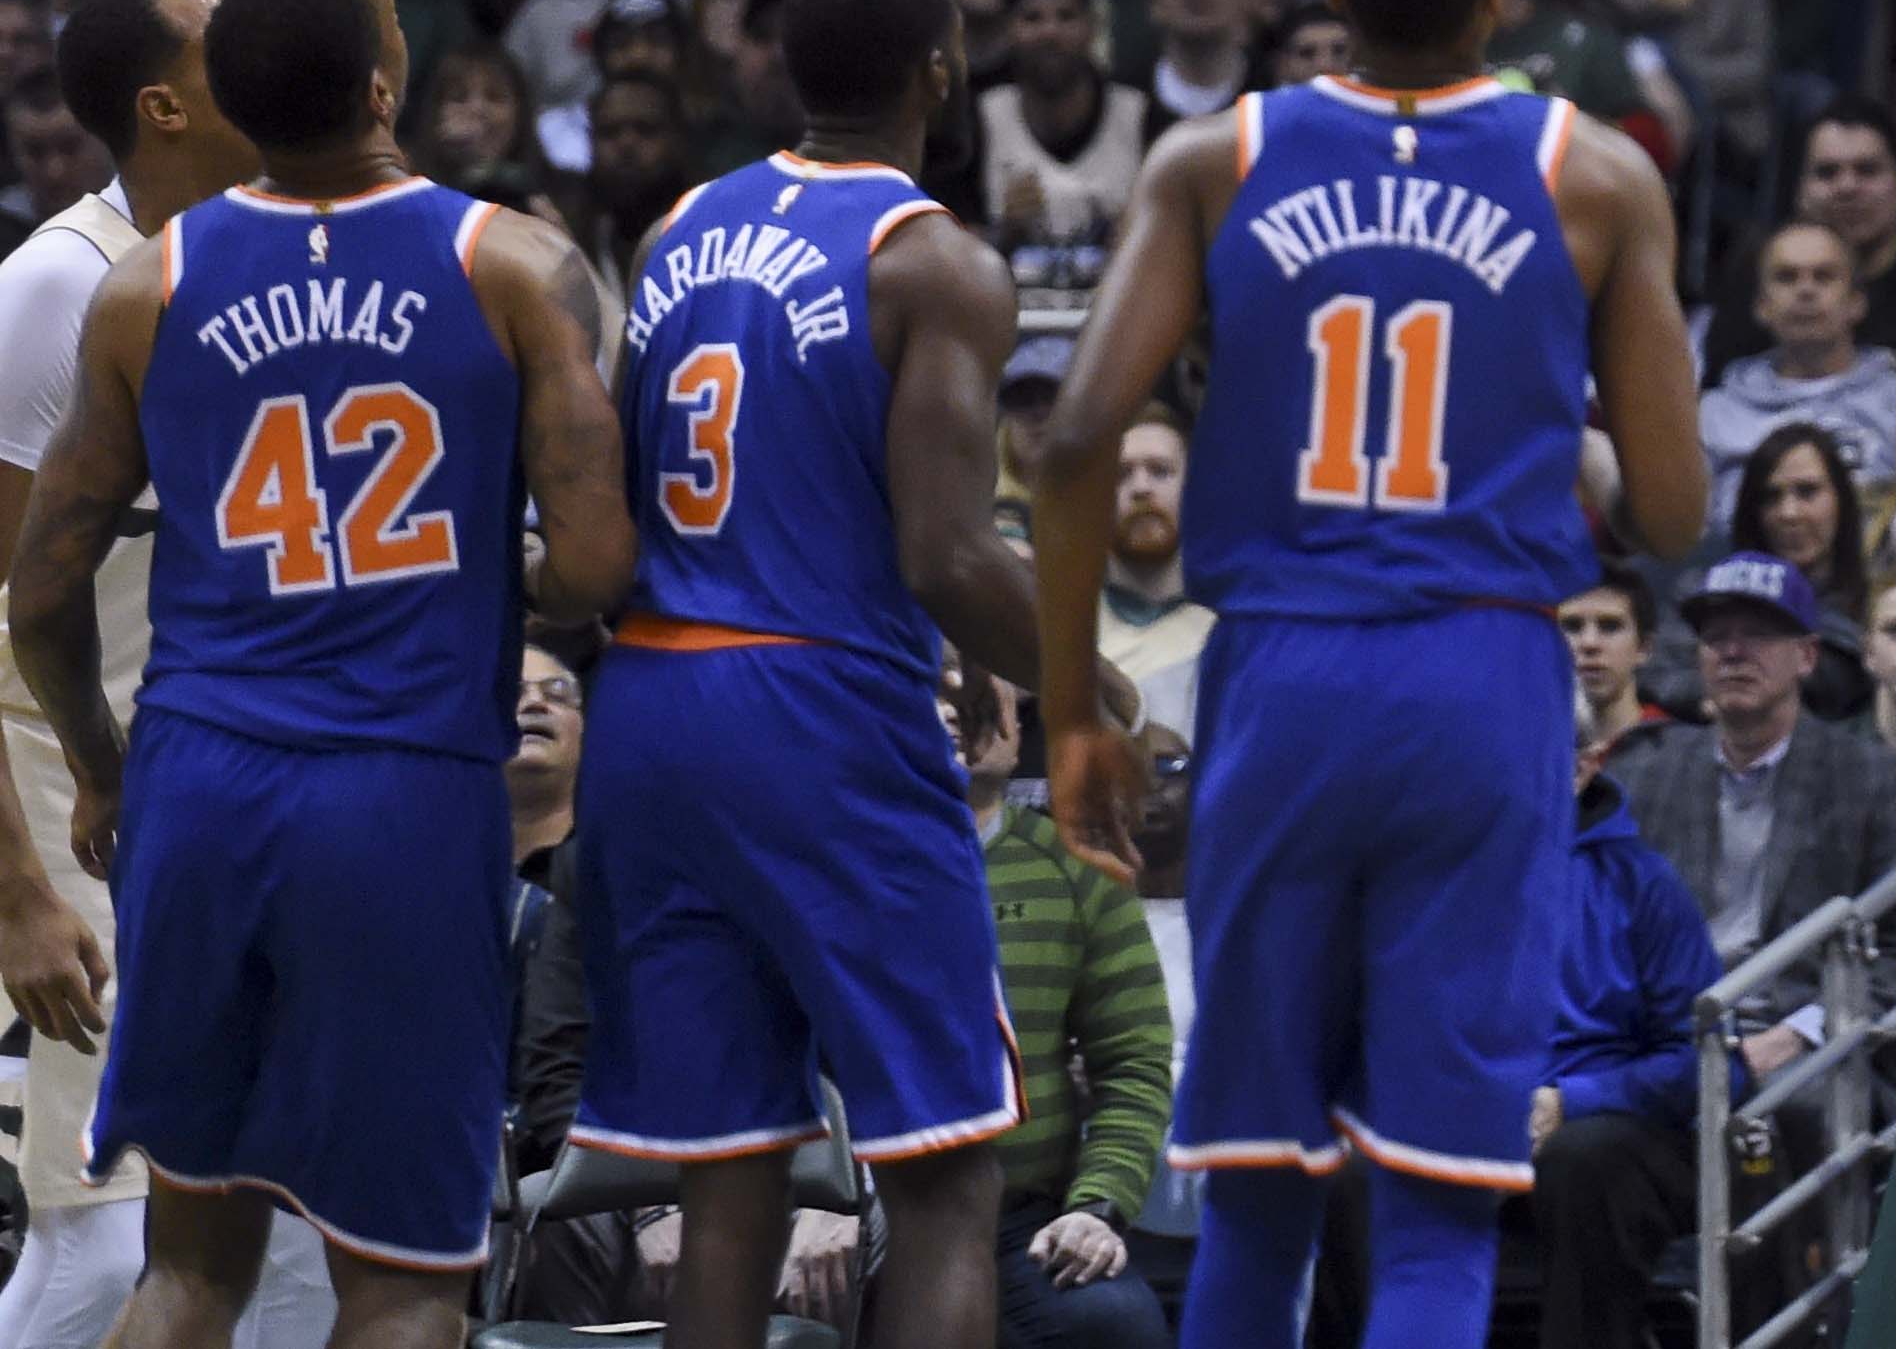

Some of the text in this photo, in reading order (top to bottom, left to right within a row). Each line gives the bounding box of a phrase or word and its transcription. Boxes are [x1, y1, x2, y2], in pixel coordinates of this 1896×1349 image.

[198, 277, 427, 376] THOMAS
[1250, 176, 1536, 293] NTILIKINA
[216, 383, 459, 595] 42
[658, 342, 746, 537] 3
[1297, 294, 1452, 510] 11
